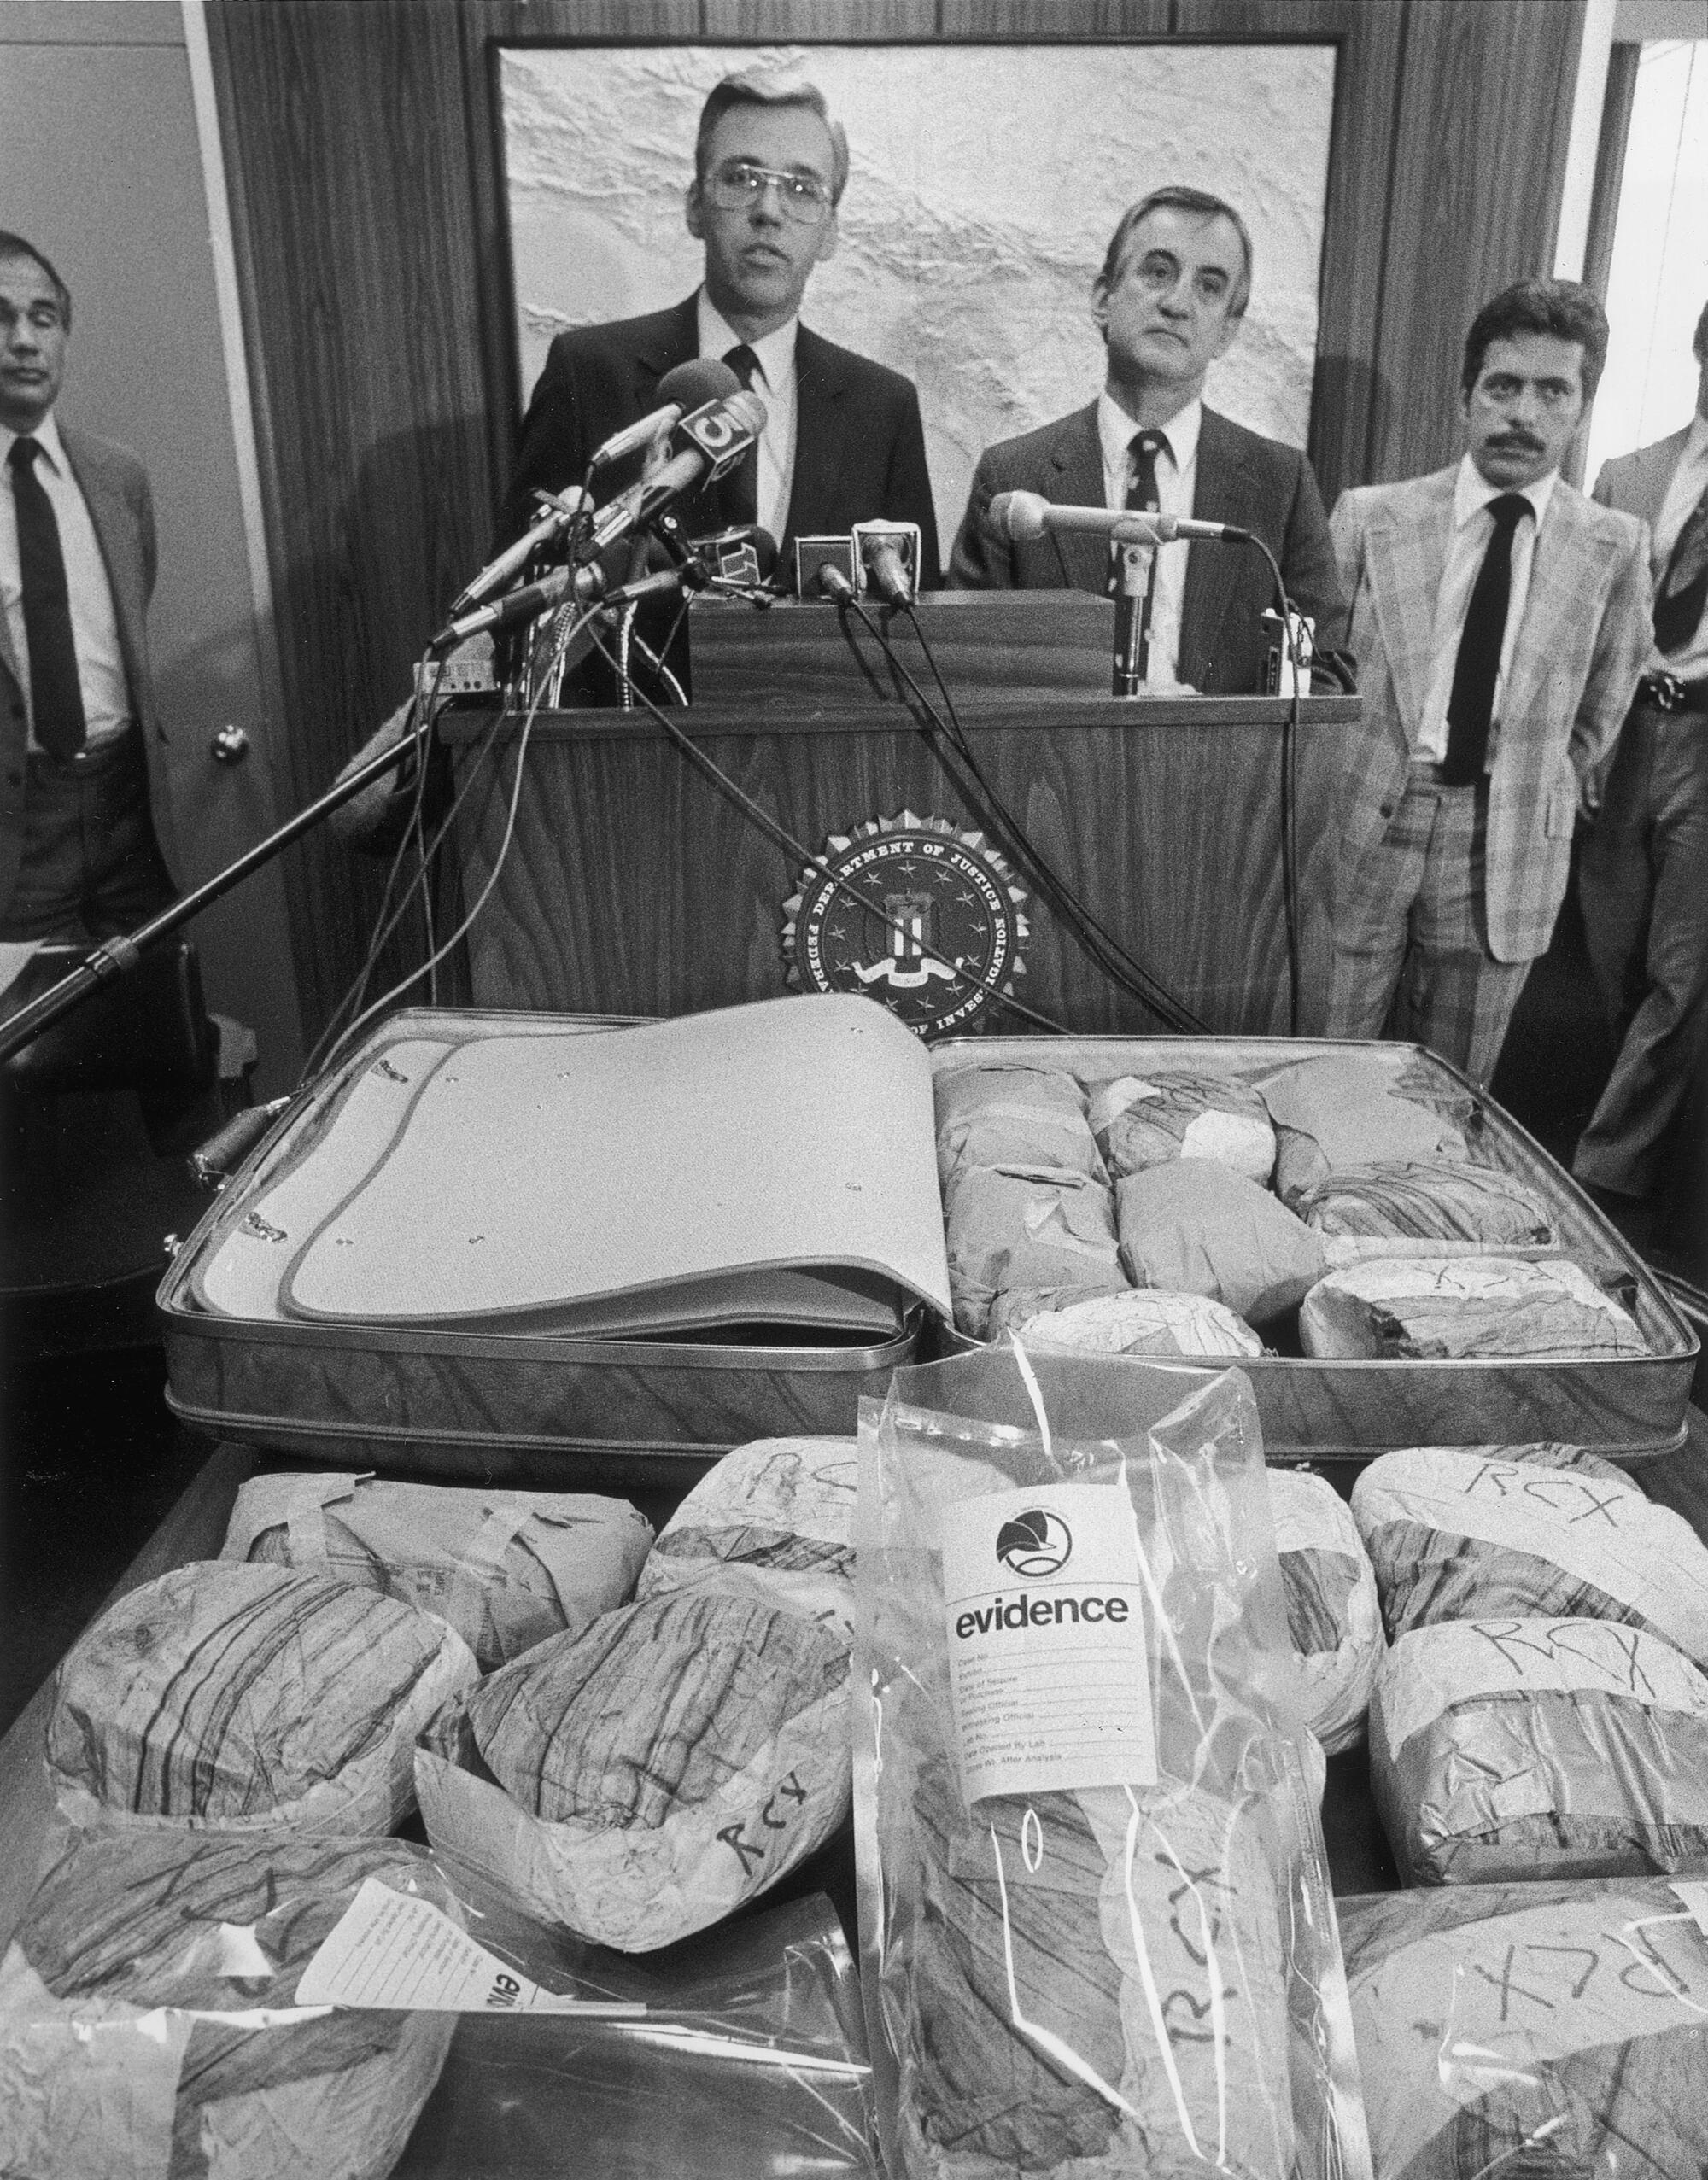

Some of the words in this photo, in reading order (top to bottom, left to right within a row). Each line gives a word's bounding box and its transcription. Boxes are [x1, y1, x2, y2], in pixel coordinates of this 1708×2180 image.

[695, 412, 744, 447] 5
[812, 841, 915, 917] DEPRTMENT
[922, 842, 945, 857] OF
[950, 852, 1003, 912] JUSTICE
[807, 923, 834, 992] FEDERA
[910, 1025, 929, 1035] OF
[1465, 1463, 1623, 1528] RCX
[955, 1593, 1130, 1639] evidence
[1003, 1711, 1035, 1722] Official
[1001, 1756, 1022, 1764] After
[1025, 1752, 1062, 1764] Analysis
[1028, 1739, 1045, 1748] Lab
